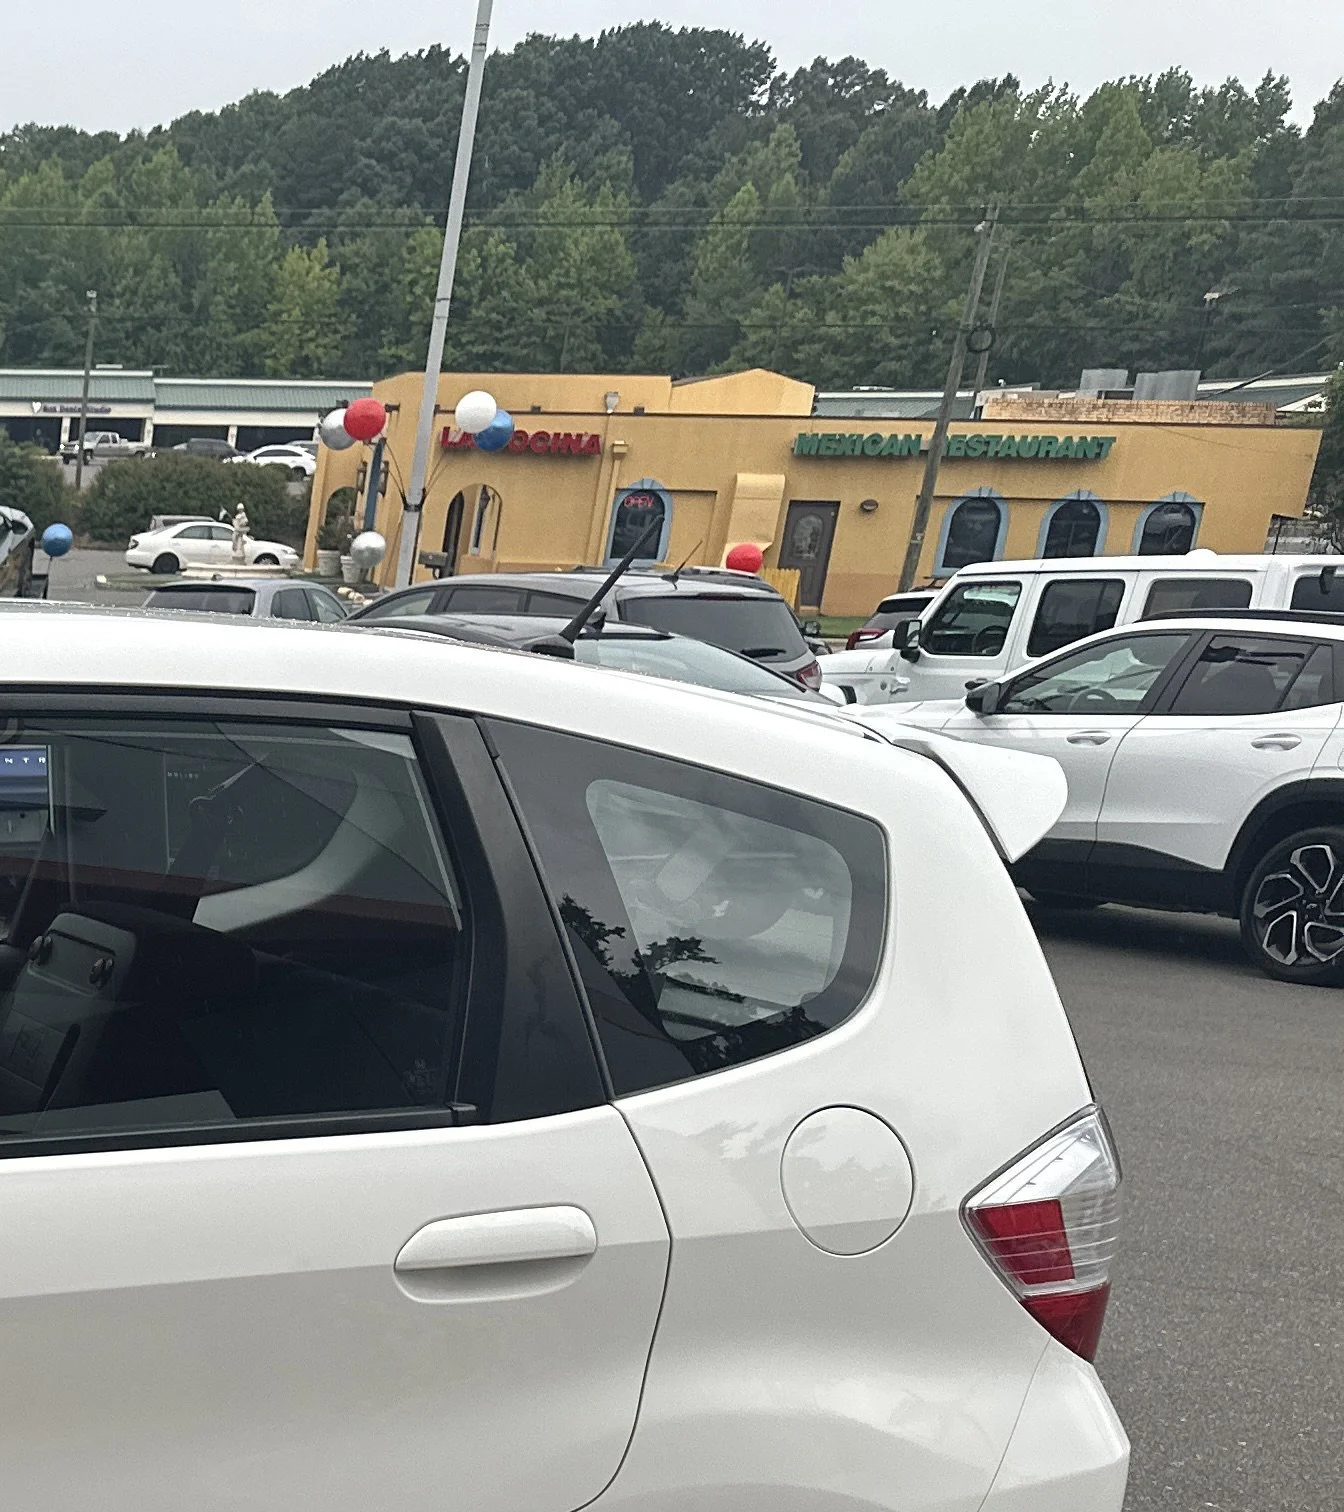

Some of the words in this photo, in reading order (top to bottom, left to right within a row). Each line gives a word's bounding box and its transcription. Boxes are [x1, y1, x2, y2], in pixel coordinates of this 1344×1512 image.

[507, 429, 602, 455] OCINA
[794, 432, 922, 457] MEXICAN
[942, 433, 1117, 459] ESTAURANT
